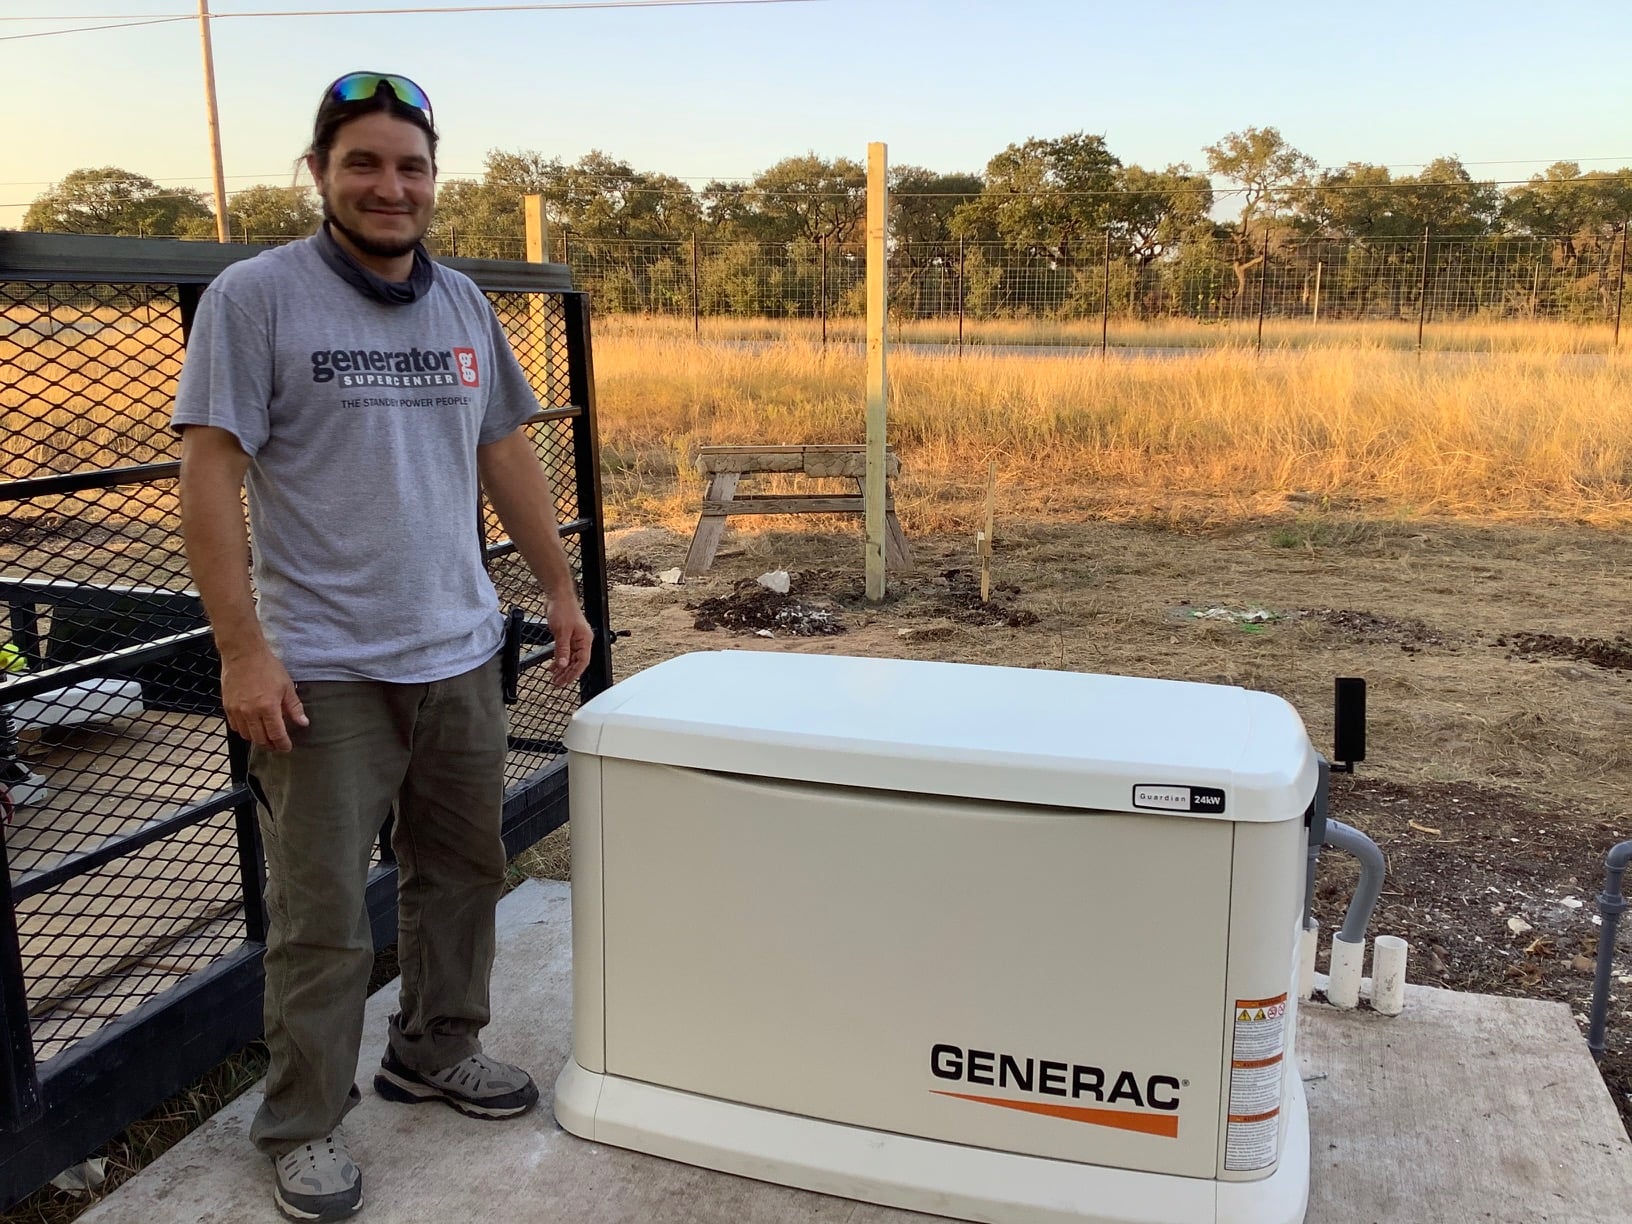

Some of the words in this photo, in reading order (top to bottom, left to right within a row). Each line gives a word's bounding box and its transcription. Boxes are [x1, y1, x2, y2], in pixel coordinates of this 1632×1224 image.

[311, 347, 452, 383] generator
[343, 373, 454, 386] SUPERCENTER
[341, 400, 361, 409] THE
[400, 399, 433, 408] POWER
[436, 396, 468, 406] PEOPLE
[1139, 792, 1186, 803] Guardian
[1194, 795, 1221, 805] 24kW
[930, 1043, 1180, 1111] GENERAC
